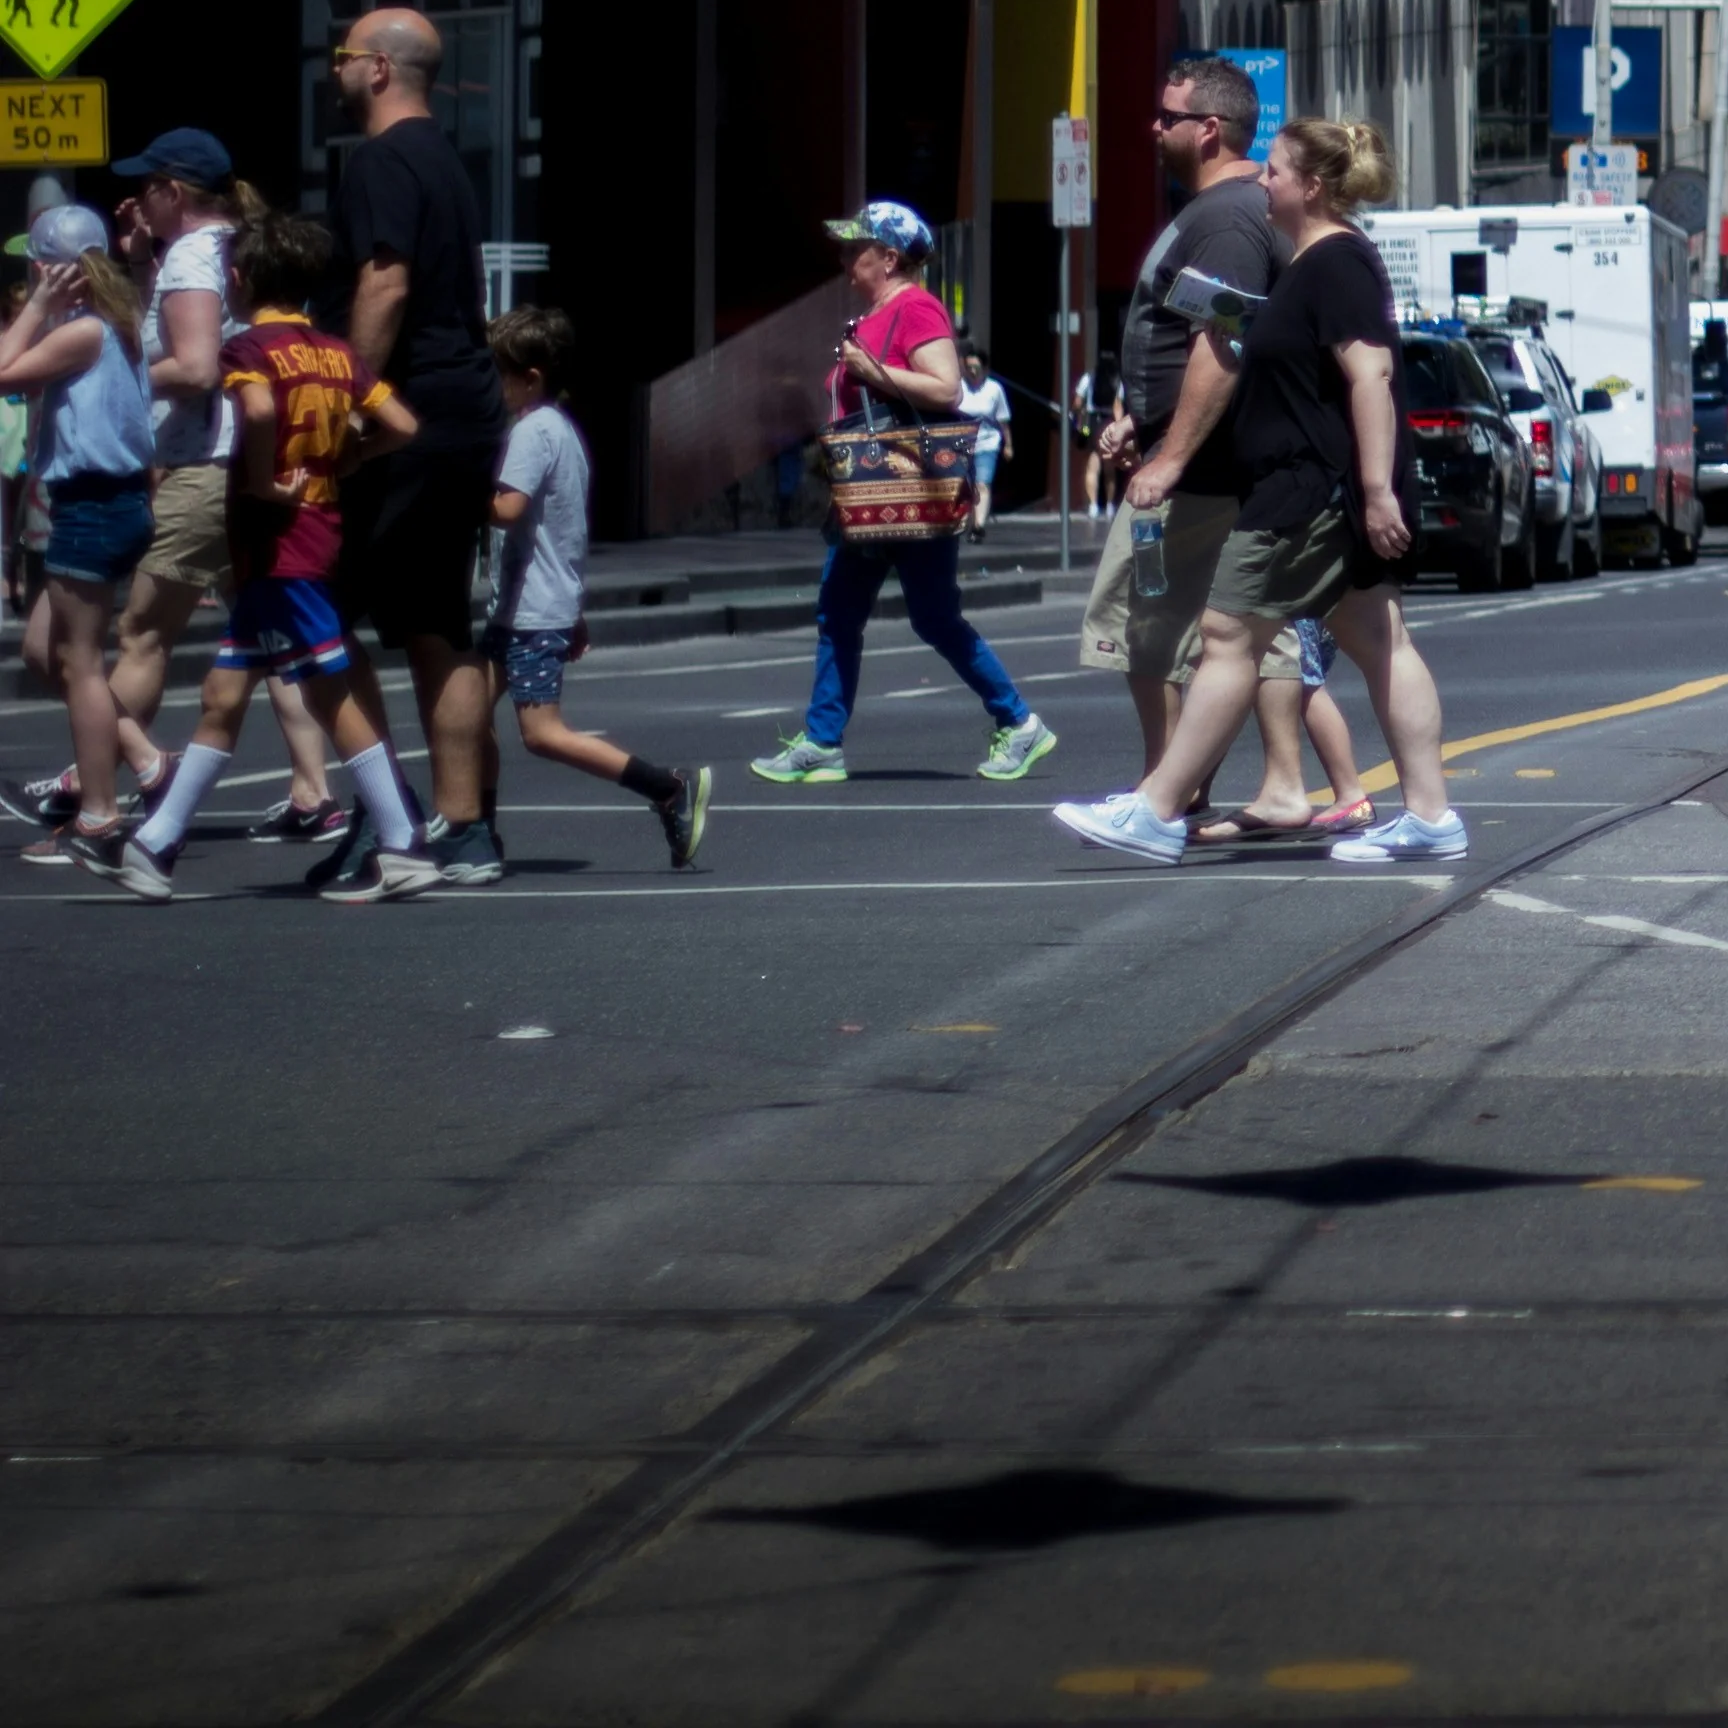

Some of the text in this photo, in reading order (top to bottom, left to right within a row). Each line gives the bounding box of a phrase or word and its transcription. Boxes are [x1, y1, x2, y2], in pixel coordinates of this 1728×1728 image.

[8, 94, 85, 119] NEXT
[14, 125, 78, 149] 50 m
[1594, 251, 1618, 266] 354
[269, 351, 298, 380] EL
